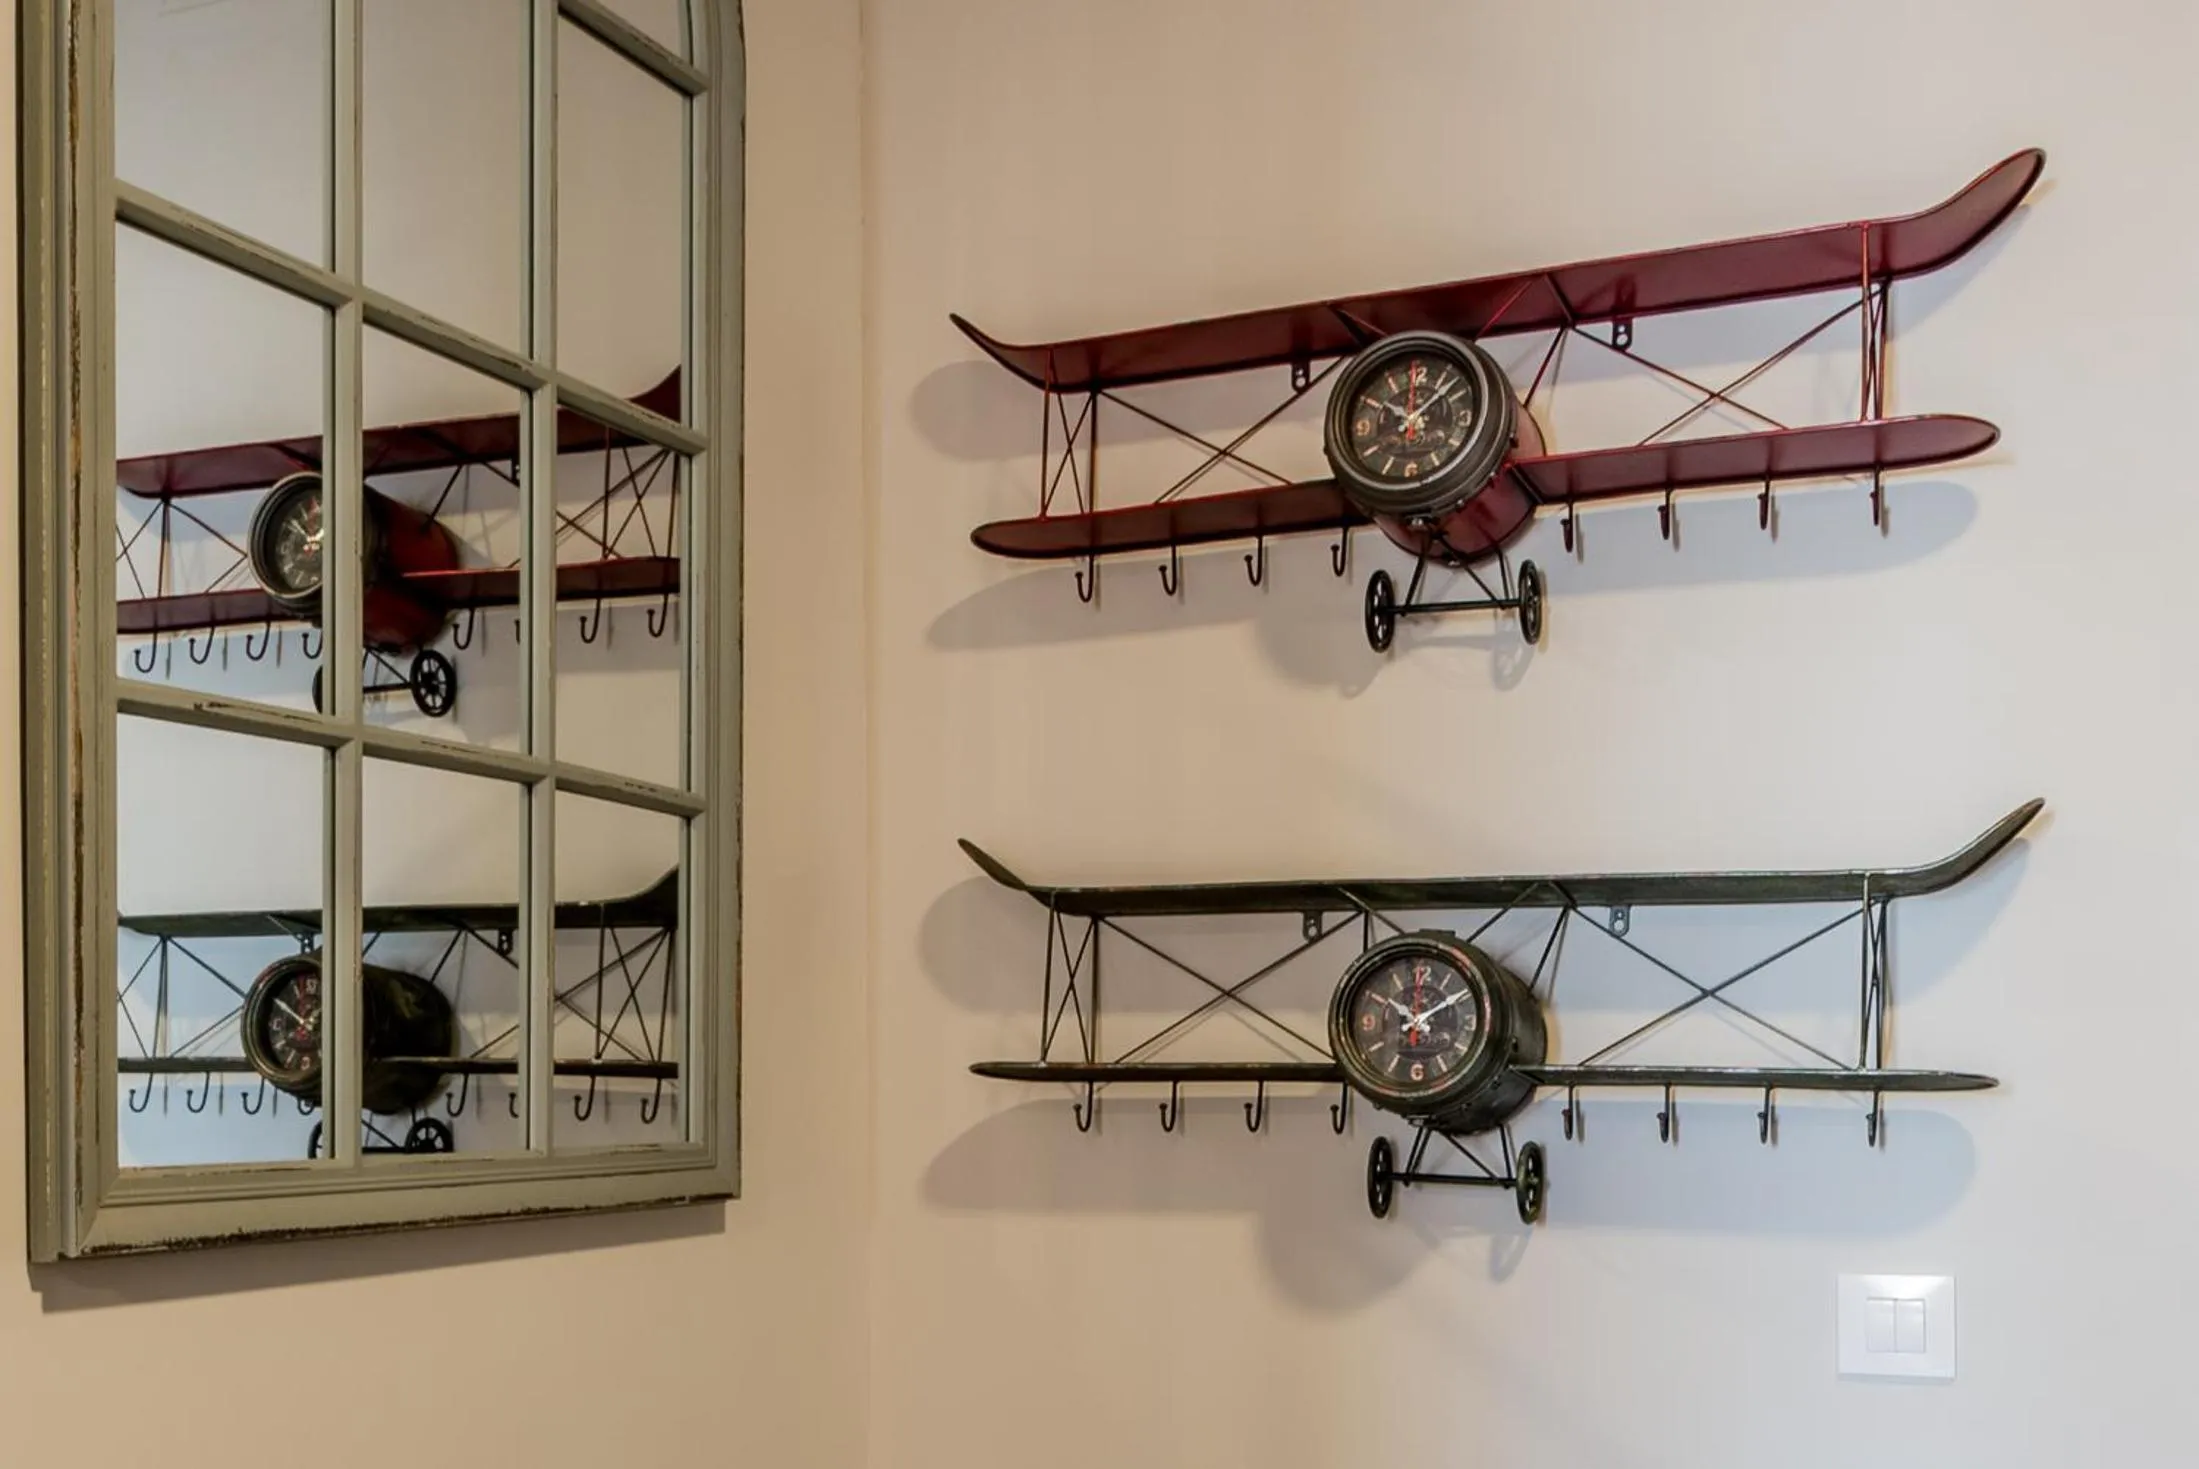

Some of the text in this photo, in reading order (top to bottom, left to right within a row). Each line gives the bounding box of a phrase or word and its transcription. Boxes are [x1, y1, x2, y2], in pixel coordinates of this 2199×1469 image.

[1459, 410, 1472, 426] 3
[1356, 419, 1370, 436] 9
[1404, 462, 1418, 478] 6
[1362, 1014, 1376, 1031] 9
[1464, 1014, 1476, 1031] 3
[1410, 1063, 1424, 1081] 6
